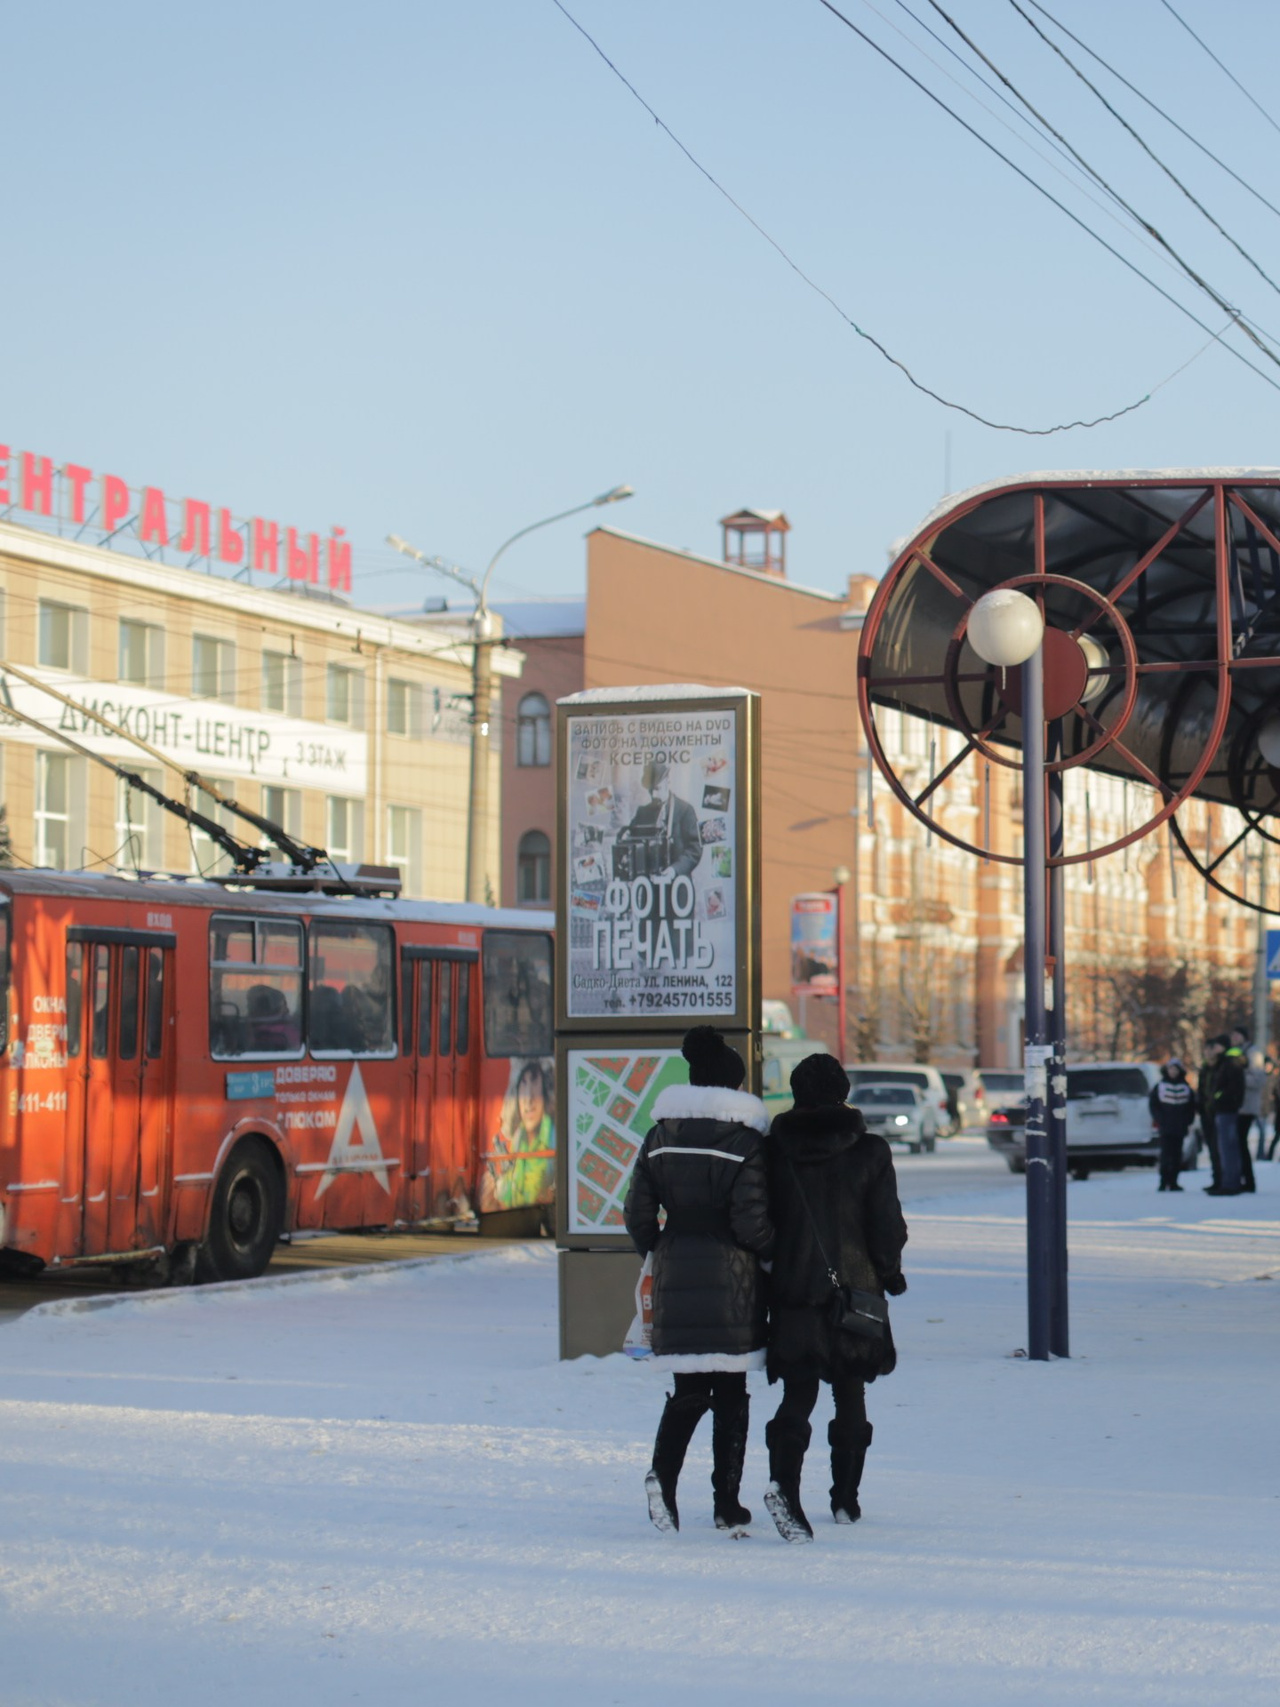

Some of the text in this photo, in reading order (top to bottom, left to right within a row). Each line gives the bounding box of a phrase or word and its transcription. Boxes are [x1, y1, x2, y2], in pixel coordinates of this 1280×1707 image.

[58, 694, 271, 763] ДИСКОНТ-ЦЕНТР
[574, 722, 624, 736] ЗАПИСЬ
[639, 720, 683, 735] ВИДЕО
[686, 720, 702, 732] НА
[706, 719, 731, 731] DVD
[581, 734, 722, 750] ФОТО НА ДОКУМЕНТЫ
[609, 750, 691, 766] КСЕРОКС
[605, 875, 695, 920] ФОТО
[593, 919, 715, 970] ПЕЧАТЬ
[715, 974, 733, 987] 122
[629, 992, 733, 1008] +79245701555
